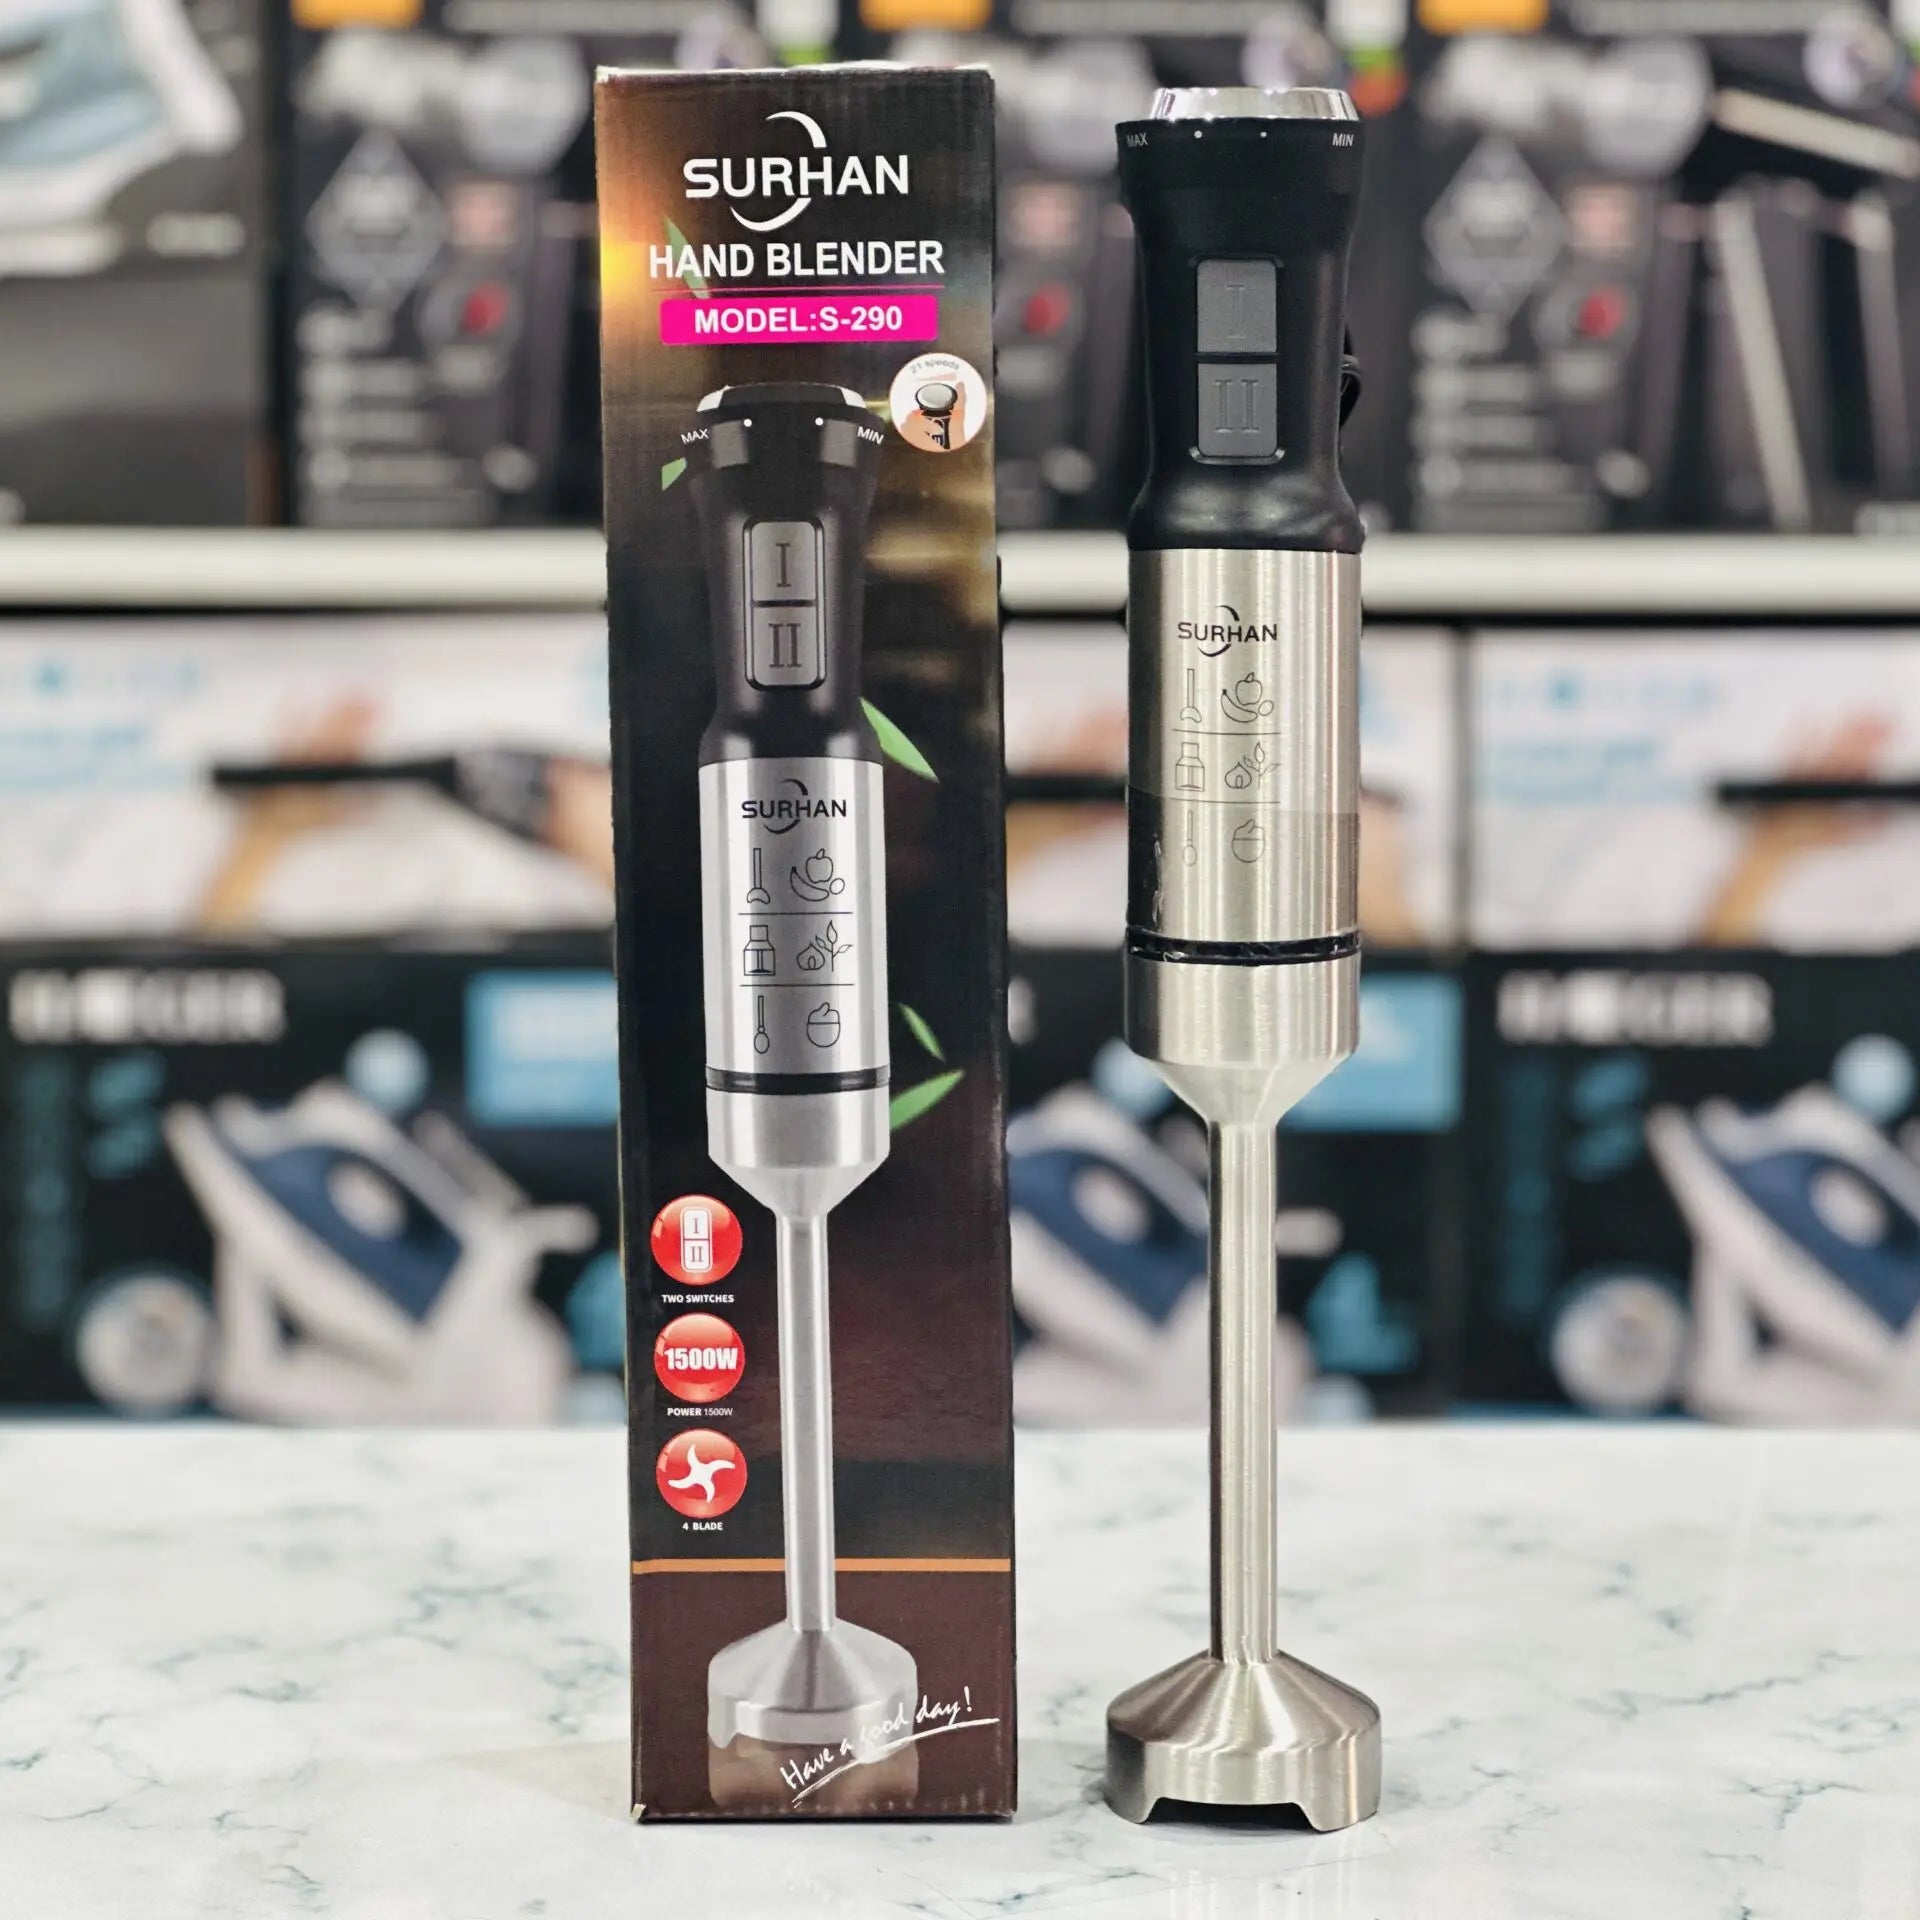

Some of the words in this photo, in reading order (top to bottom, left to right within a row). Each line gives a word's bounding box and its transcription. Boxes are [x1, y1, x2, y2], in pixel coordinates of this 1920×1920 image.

[1126, 132, 1149, 147] MAX
[1332, 133, 1354, 147] MIN
[683, 154, 909, 198] SURHAN
[649, 243, 755, 278] HAND
[766, 240, 945, 276] BLENDER
[694, 305, 903, 334] MODEL:S-290
[910, 362, 922, 374] 21
[925, 359, 960, 370] speeds
[1214, 379, 1260, 434] II
[681, 428, 709, 445] MAX
[857, 426, 884, 445] MIN
[776, 542, 792, 588] I
[1177, 621, 1278, 643] SURHAN
[768, 622, 802, 668] II
[741, 799, 847, 819] SURHAN
[690, 1245, 704, 1263] II
[661, 1294, 684, 1303] TWO
[686, 1294, 735, 1303] SWITCHES
[663, 1347, 739, 1370] 1500W
[667, 1407, 702, 1416] POWER
[704, 1407, 734, 1416] 1500W
[682, 1522, 689, 1531] 4
[693, 1522, 724, 1531] BLADE
[780, 1747, 835, 1790] Have
[840, 1737, 854, 1756] a
